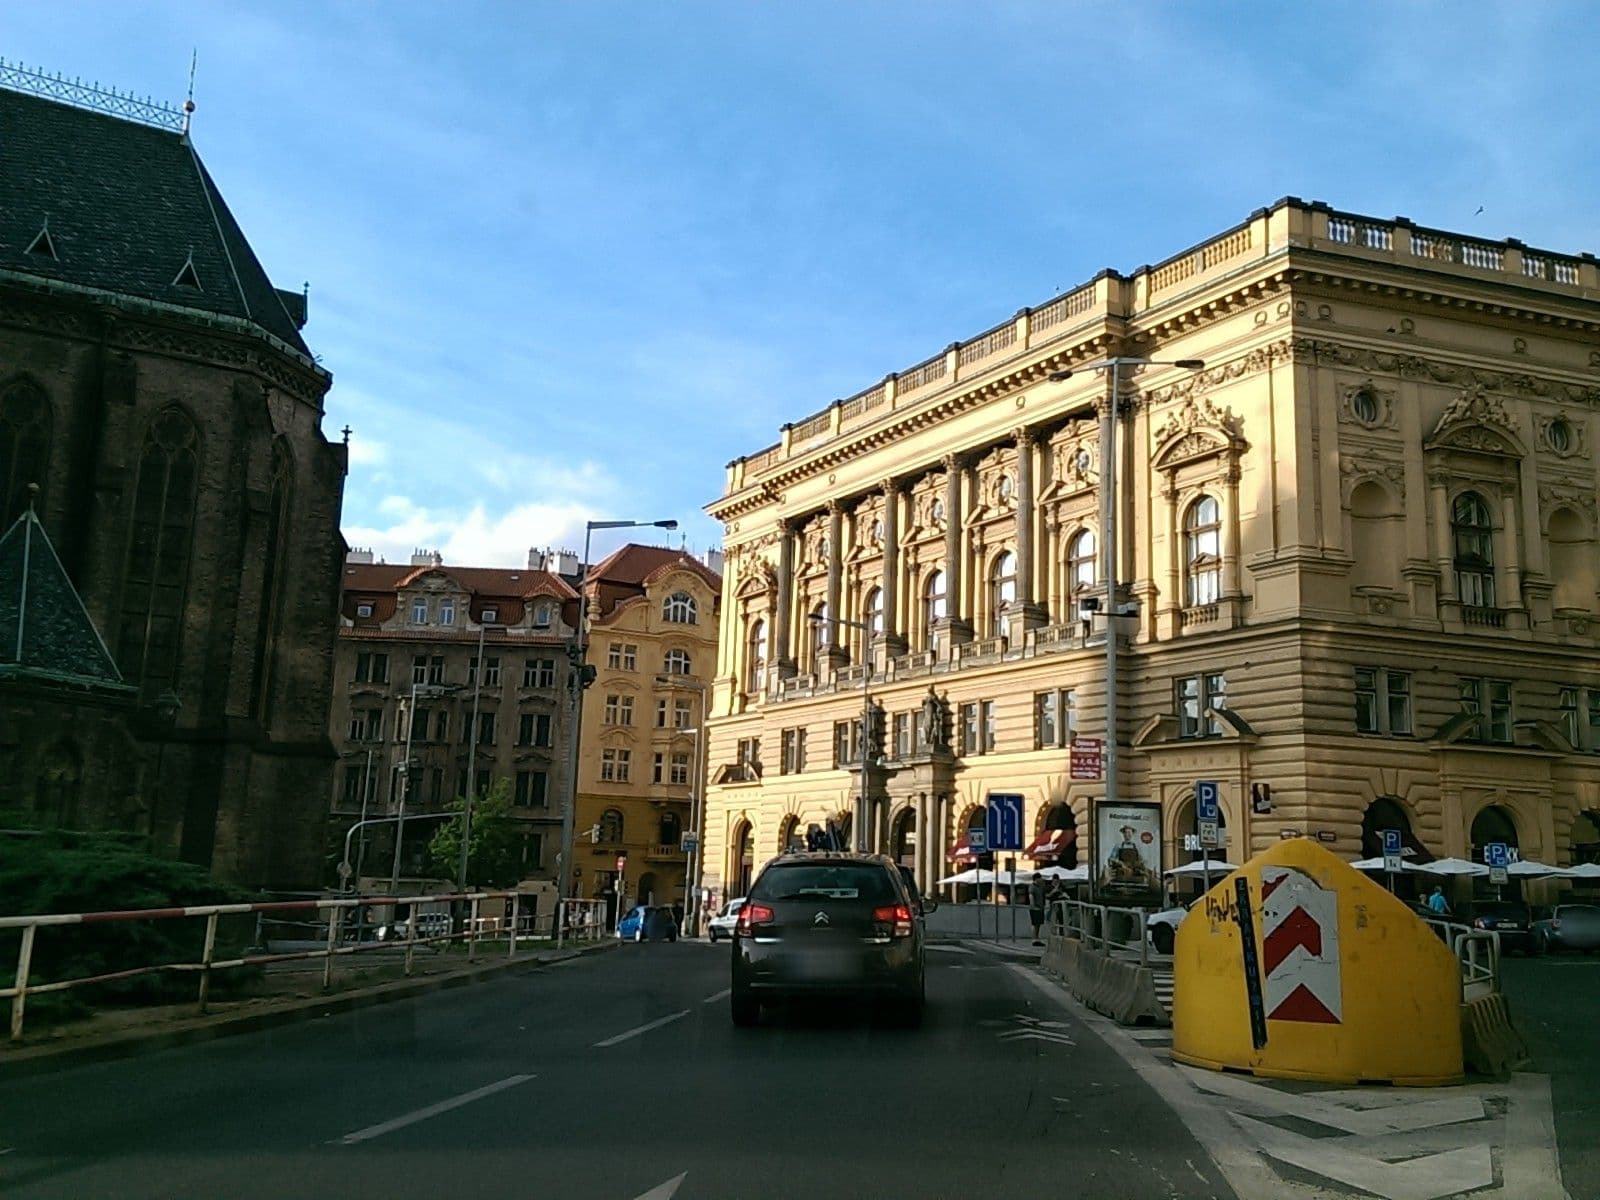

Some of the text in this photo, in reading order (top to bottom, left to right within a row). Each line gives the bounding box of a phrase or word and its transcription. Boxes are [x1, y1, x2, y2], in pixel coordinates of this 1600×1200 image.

[1201, 786, 1214, 808] P
[1386, 832, 1397, 847] P
[1483, 845, 1519, 864] BXX
[1491, 845, 1503, 859] P
